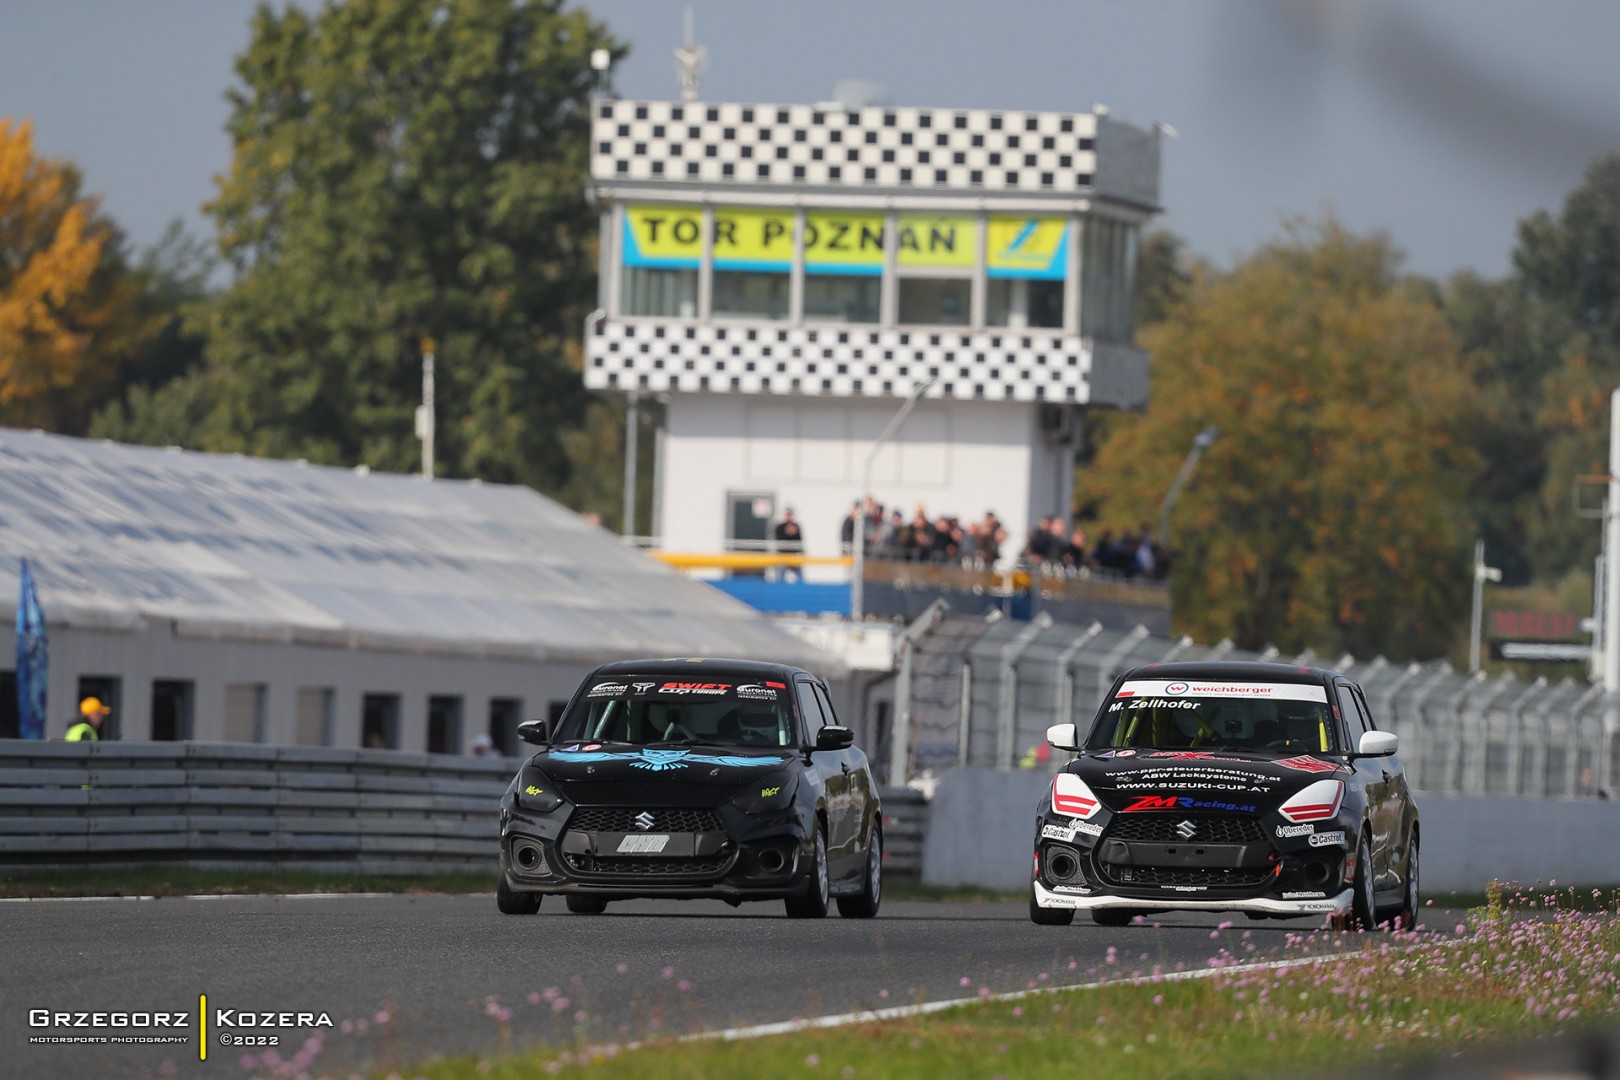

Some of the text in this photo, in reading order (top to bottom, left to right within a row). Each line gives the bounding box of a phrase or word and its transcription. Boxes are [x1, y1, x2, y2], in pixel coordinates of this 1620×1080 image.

[642, 217, 957, 253] TOR POZNAŃ
[662, 682, 732, 690] SWIFT
[1192, 686, 1273, 694] weichberger
[1108, 699, 1201, 713] M. Zellhofer
[1105, 766, 1281, 782] www.ppr-steuerberatung.at
[1141, 772, 1170, 780] ABW
[1318, 833, 1342, 844] Castrol
